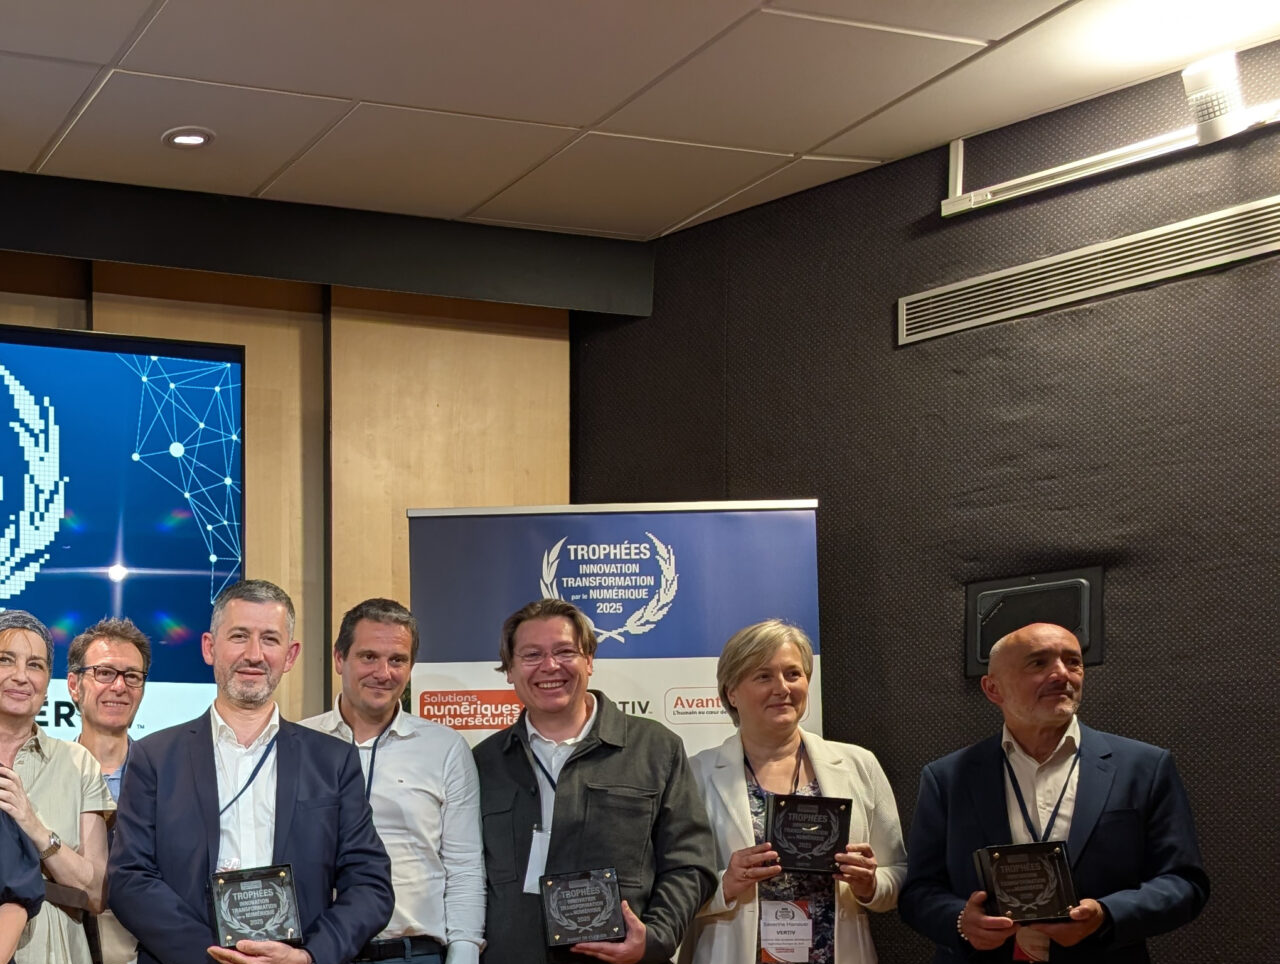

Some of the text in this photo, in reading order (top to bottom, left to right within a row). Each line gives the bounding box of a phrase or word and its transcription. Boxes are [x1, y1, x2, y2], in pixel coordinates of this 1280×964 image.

[567, 540, 651, 560] TROPHÉES
[579, 563, 639, 574] INNOVATION
[562, 575, 655, 587] TRANSFORMATION
[589, 587, 649, 599] NUMÉRIQUE
[596, 602, 623, 614] 2025
[424, 693, 478, 703] Solutions
